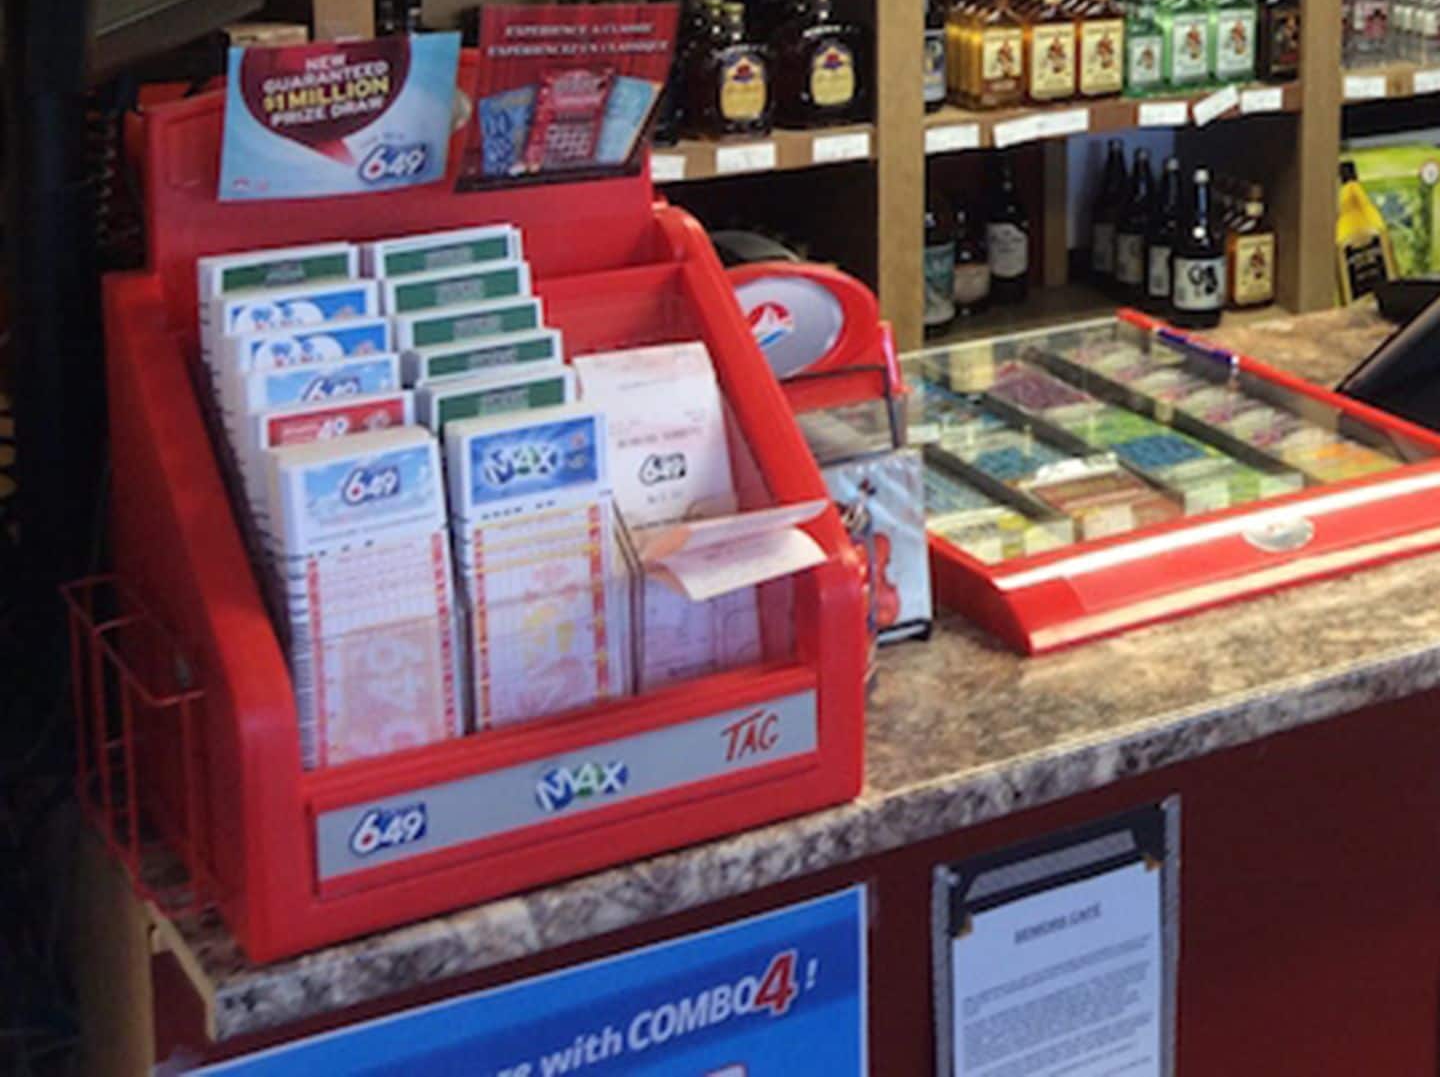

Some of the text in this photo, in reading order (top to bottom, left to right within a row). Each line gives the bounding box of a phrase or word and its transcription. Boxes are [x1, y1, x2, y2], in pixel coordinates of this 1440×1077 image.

[262, 60, 391, 94] GUARANTEED
[304, 54, 347, 71] NEW
[288, 76, 391, 110] MILLION
[270, 97, 386, 127] PRIZE DRAW
[536, 760, 629, 811] MAX
[541, 1028, 623, 1077] with
